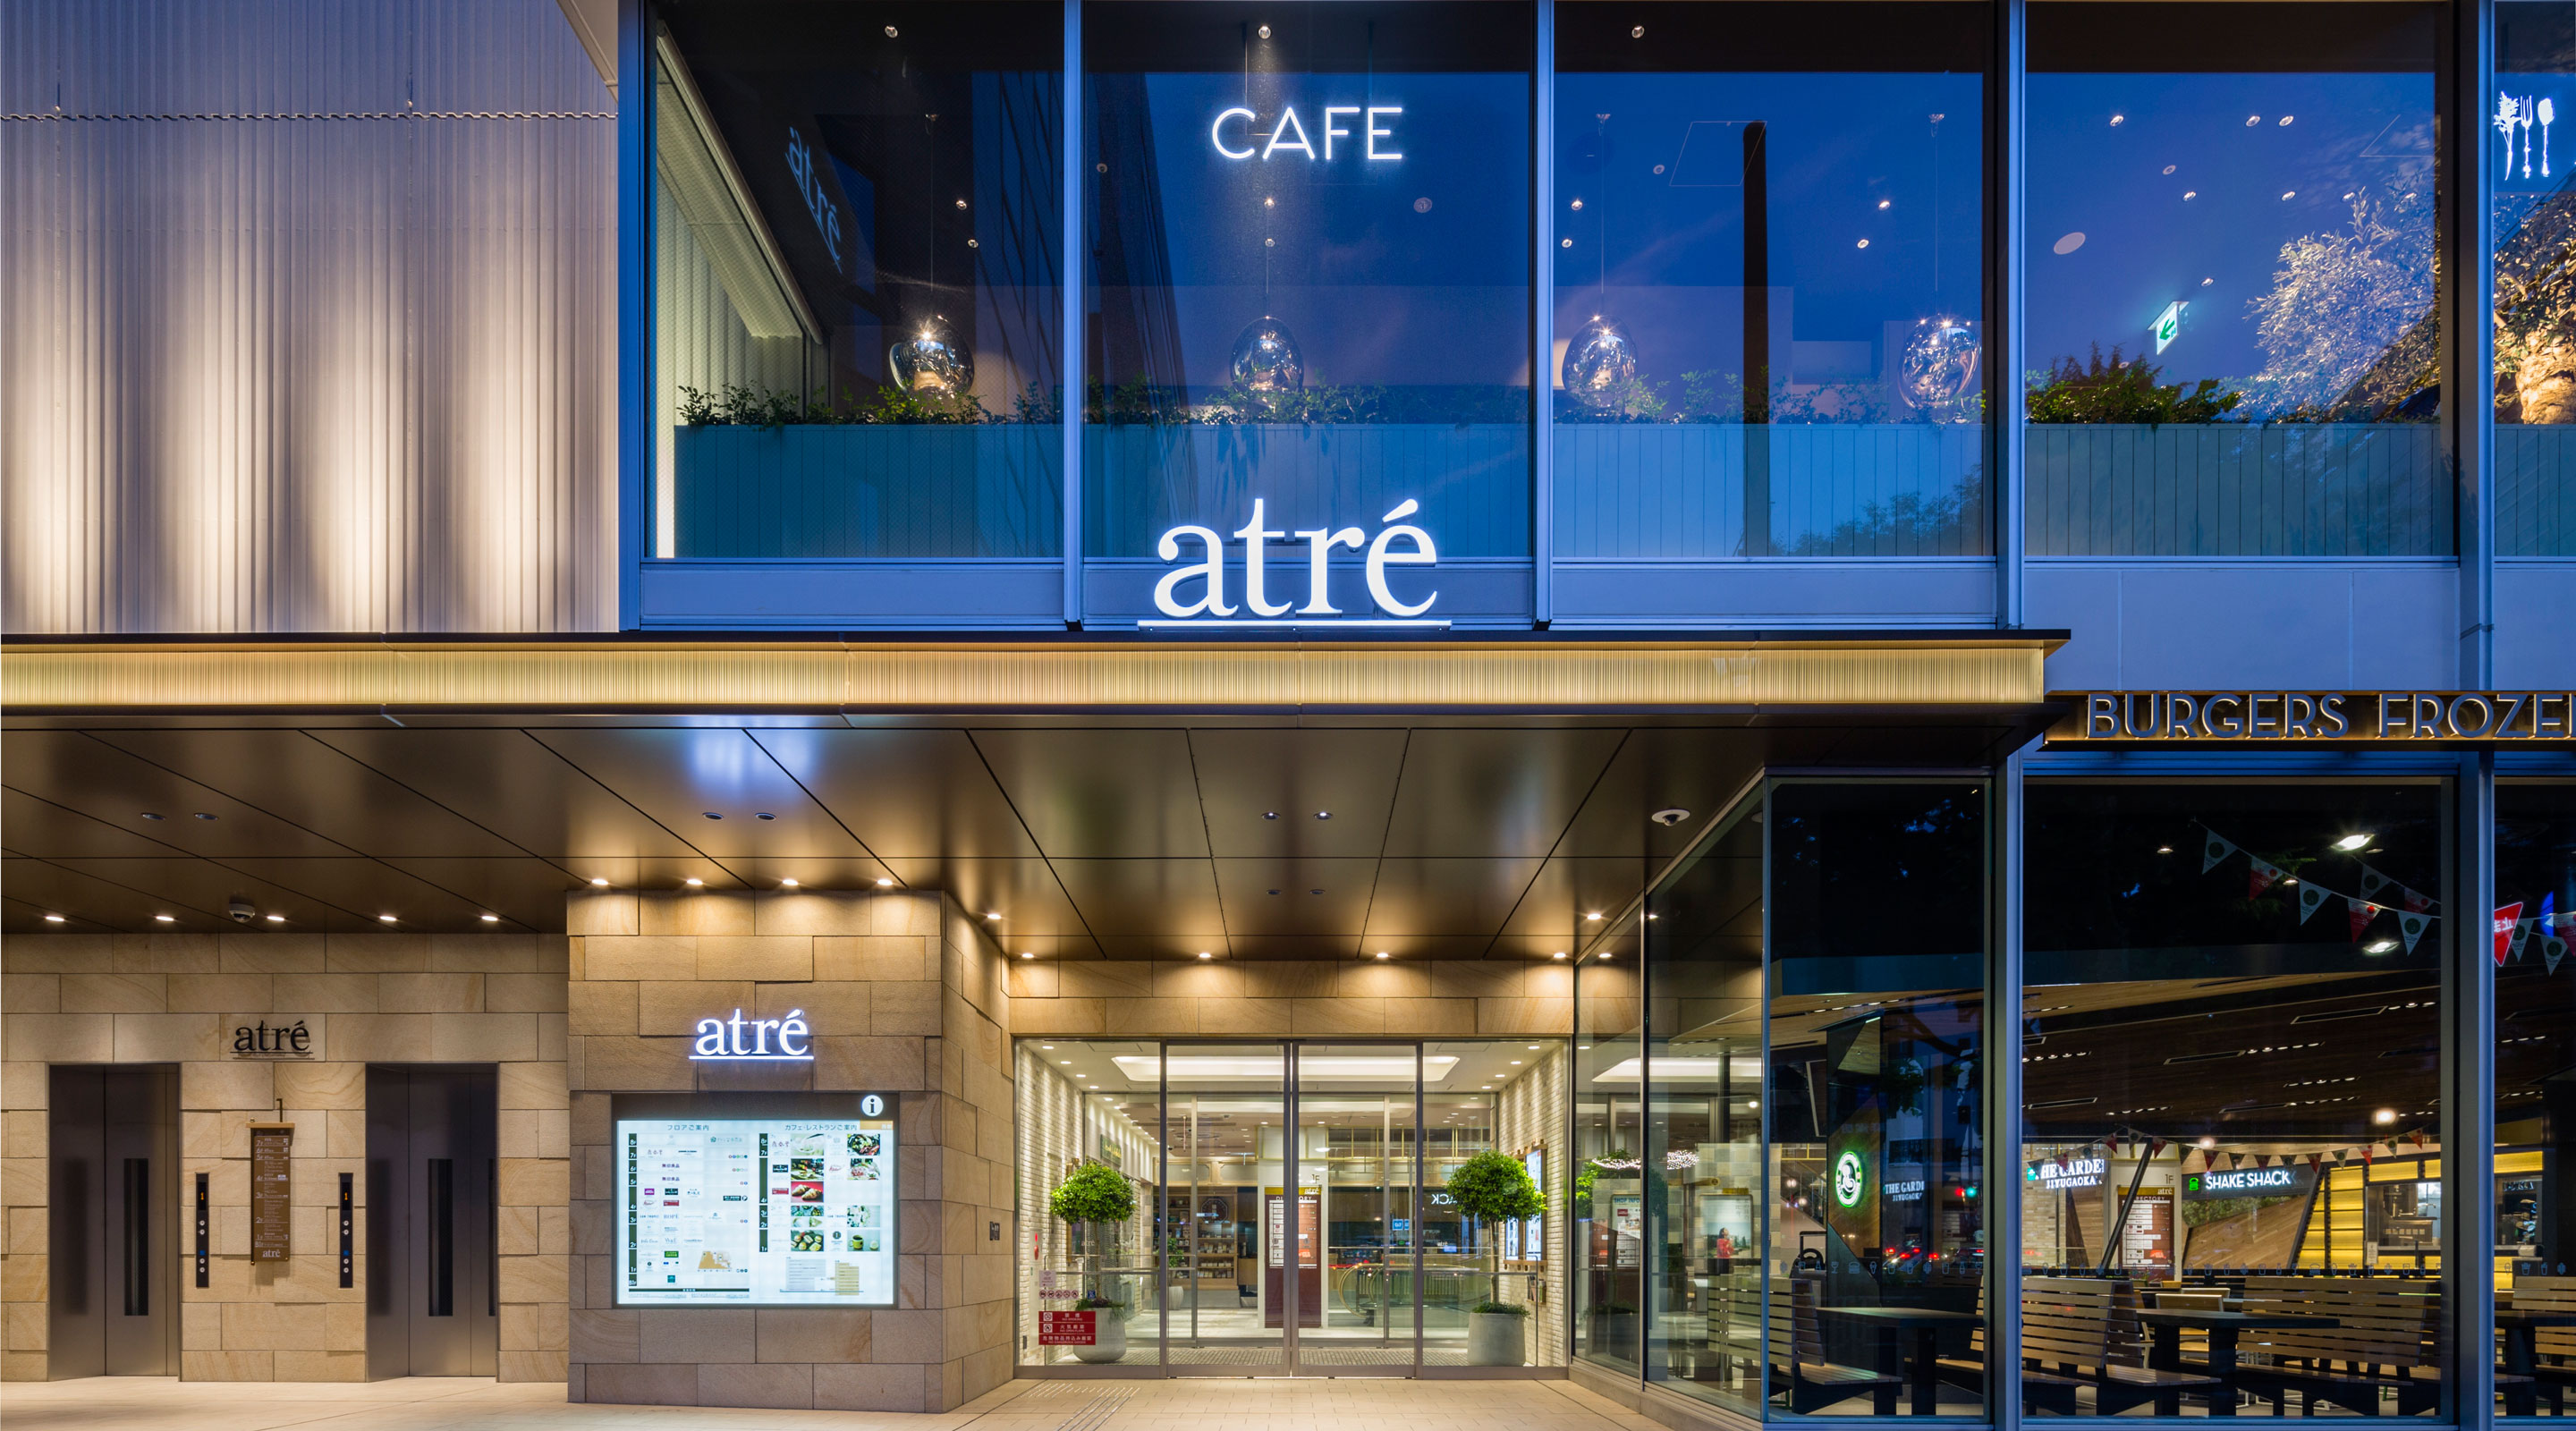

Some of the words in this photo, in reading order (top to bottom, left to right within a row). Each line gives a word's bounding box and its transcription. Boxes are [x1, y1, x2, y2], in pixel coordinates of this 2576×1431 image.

[1212, 106, 1402, 160] CAFE
[789, 126, 841, 260] atré
[1154, 498, 1437, 618] atré
[2087, 693, 2350, 739] BURGERS
[2378, 693, 2576, 739] FROZE
[233, 1020, 309, 1051] atré
[696, 1008, 809, 1055] atré
[2058, 1159, 2104, 1177] GARDE
[1885, 1182, 1900, 1194] THE
[2165, 1174, 2174, 1184] 1F
[2205, 1173, 2245, 1190] SHAKE
[2246, 1170, 2291, 1187] SHACK
[200, 1192, 204, 1200] 1
[344, 1192, 348, 1200] 1
[262, 1249, 281, 1257] atré
